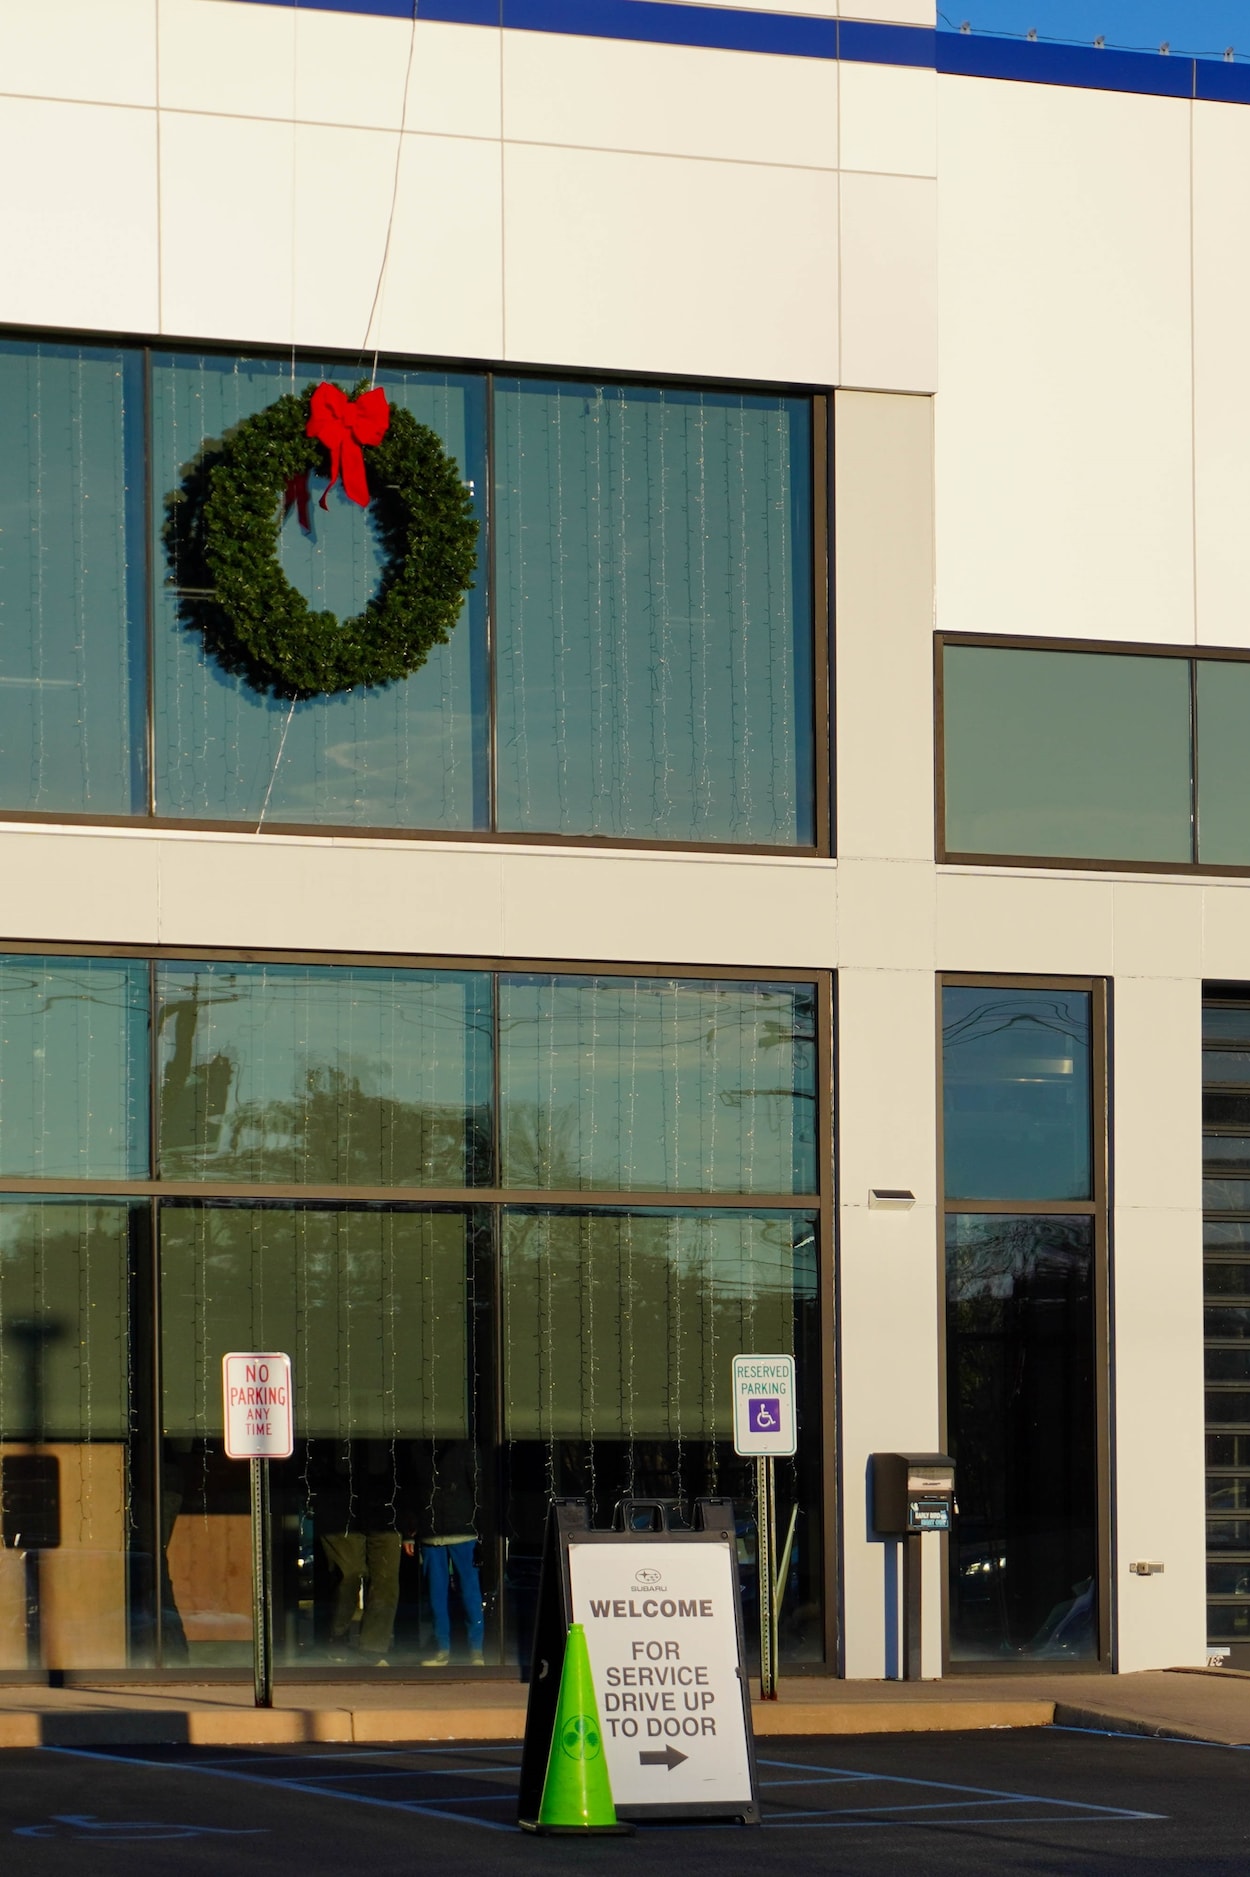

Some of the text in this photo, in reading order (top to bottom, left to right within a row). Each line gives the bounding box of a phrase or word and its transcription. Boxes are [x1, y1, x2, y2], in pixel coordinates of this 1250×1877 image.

[245, 1364, 270, 1383] NO
[737, 1365, 789, 1378] RESERVED
[231, 1386, 286, 1406] PARKING
[741, 1382, 787, 1395] PARKING
[246, 1408, 271, 1420] ANY
[245, 1423, 273, 1436] TIME
[589, 1599, 714, 1618] WELCOME
[631, 1641, 680, 1660] FOR
[606, 1666, 710, 1687] SERVICE
[604, 1691, 715, 1712] DRIVE UP
[606, 1716, 717, 1737] TO DOOR
